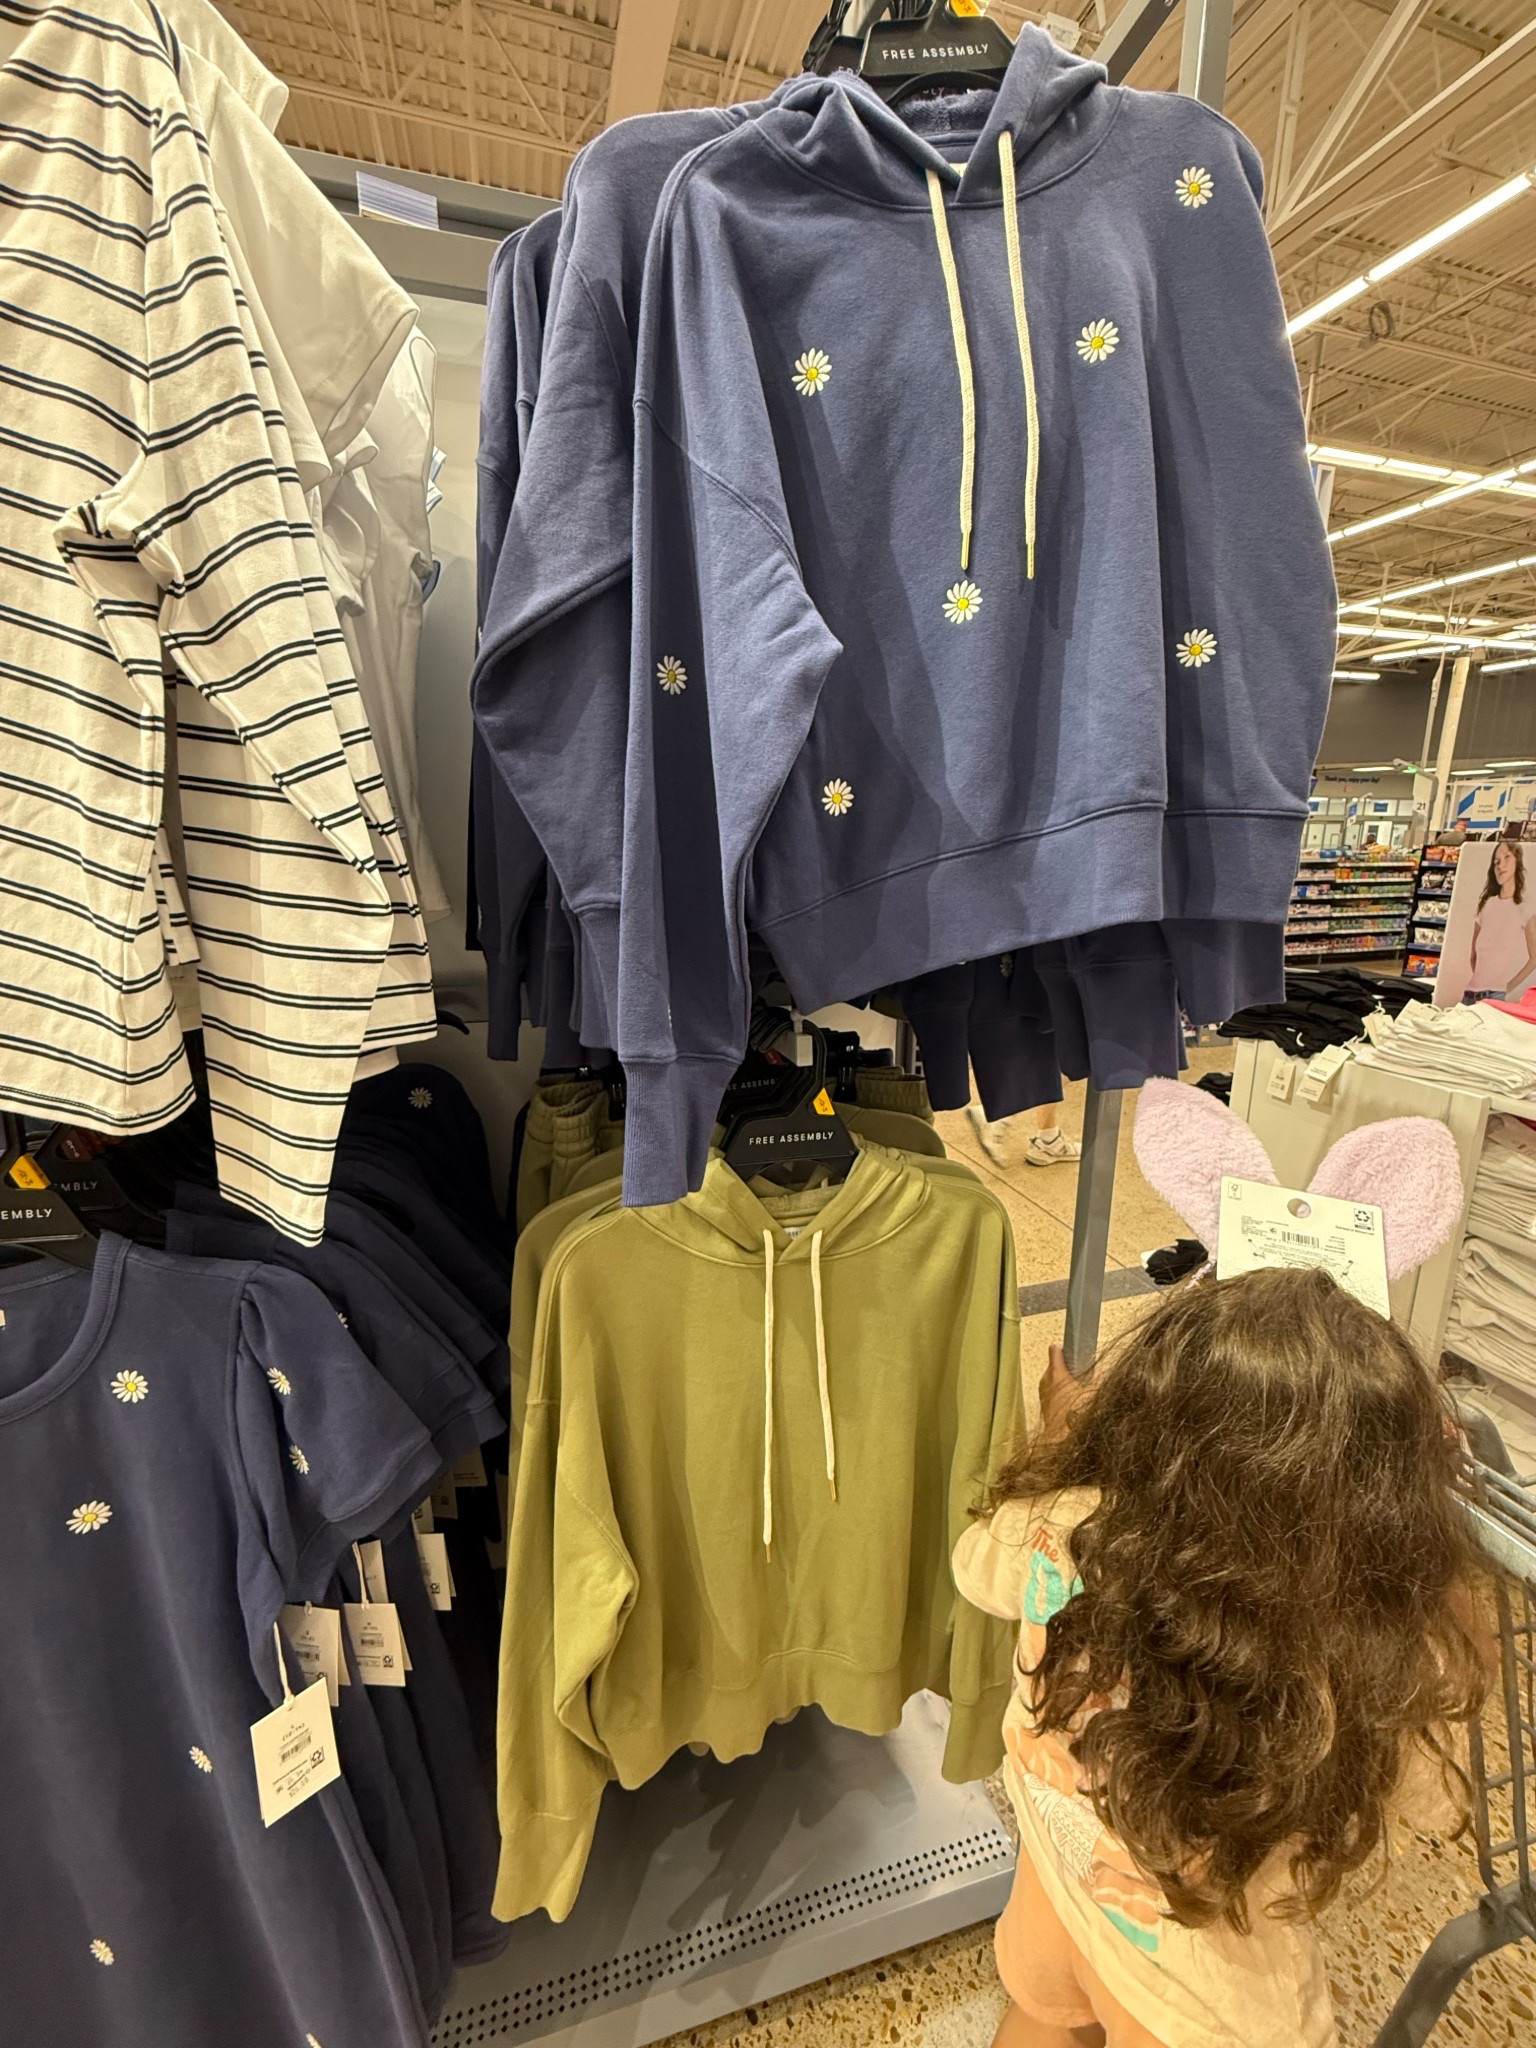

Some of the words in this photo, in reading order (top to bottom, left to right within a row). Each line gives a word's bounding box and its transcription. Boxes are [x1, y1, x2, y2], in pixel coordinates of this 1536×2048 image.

[882, 49, 916, 60] FREE
[922, 43, 989, 58] ASSEMBLY
[1416, 803, 1426, 811] 21
[749, 1136, 775, 1146] FREE
[780, 1131, 834, 1144] ASSEMBLY
[1032, 1527, 1059, 1563] The
